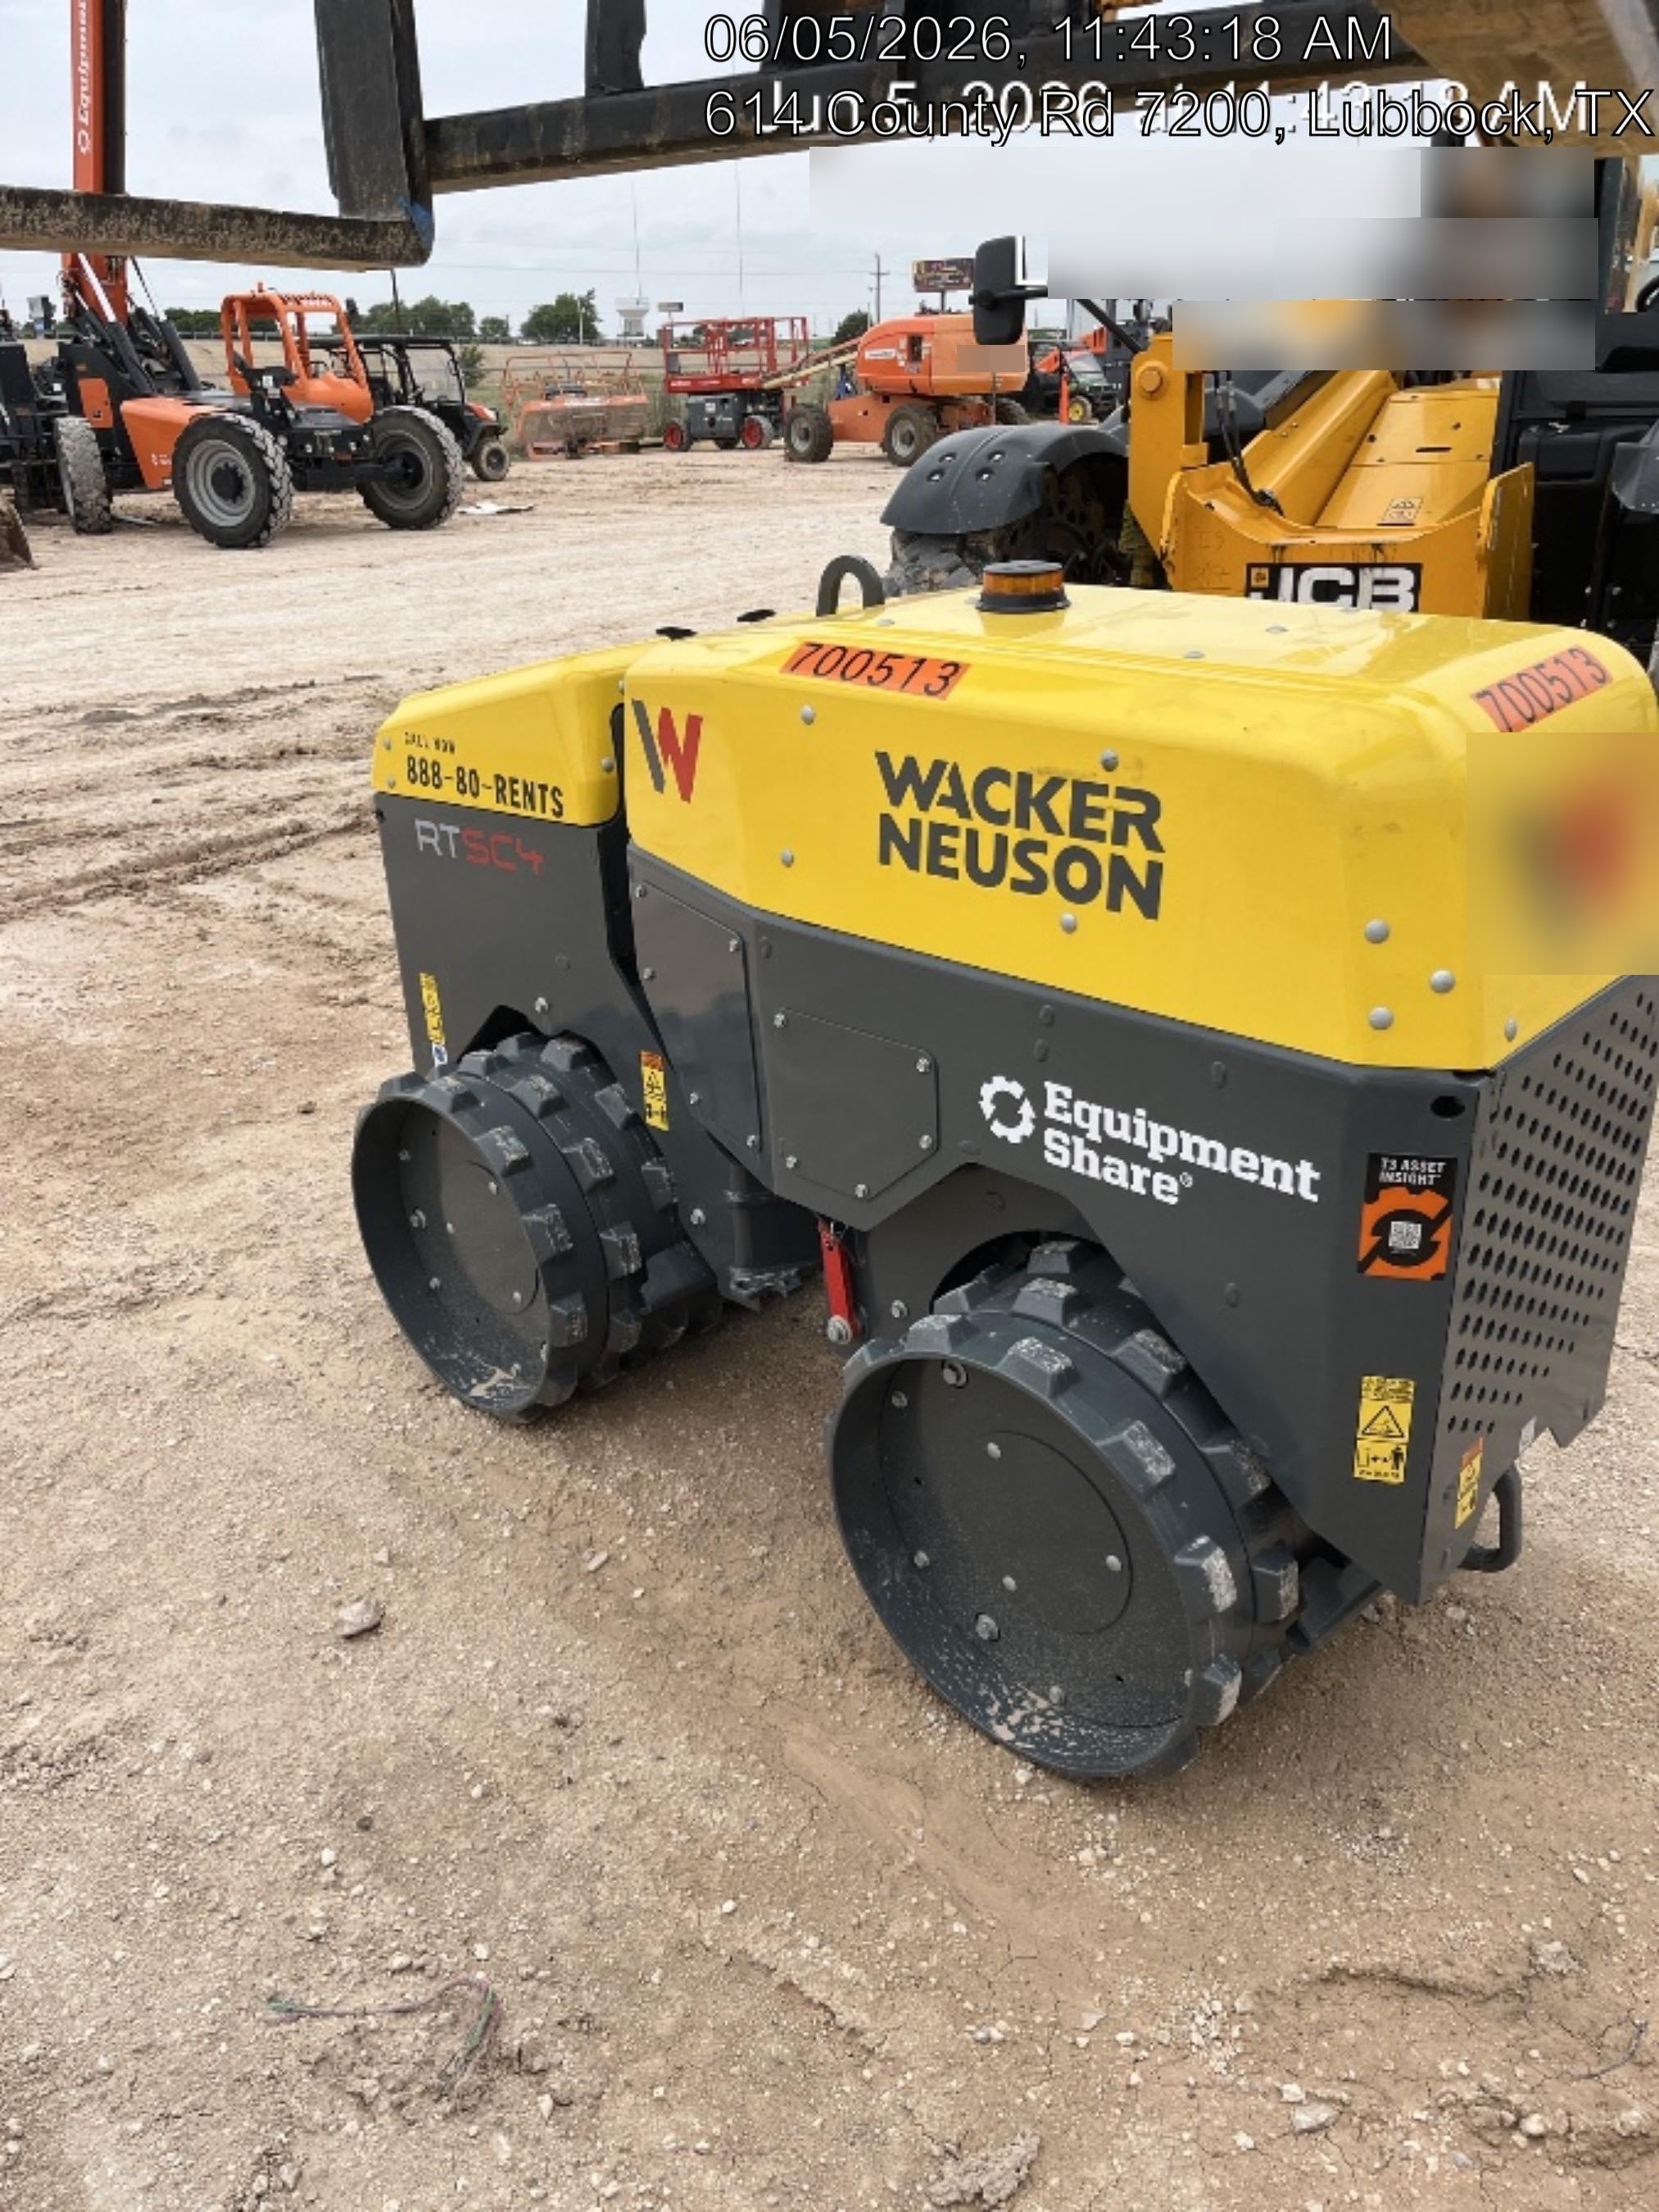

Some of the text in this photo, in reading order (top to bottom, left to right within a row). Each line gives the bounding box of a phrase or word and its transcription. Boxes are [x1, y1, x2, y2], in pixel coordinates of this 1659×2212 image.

[1249, 567, 1416, 612] JCB
[791, 641, 960, 696] 700513
[1475, 647, 1607, 732] 700513
[406, 755, 564, 818] 888-80-RENTS
[874, 750, 1165, 853] WACKER
[415, 819, 544, 877] RTSC4
[878, 813, 1163, 921] NEUSON
[1043, 1080, 1321, 1203] Equipment
[1400, 1158, 1447, 1173] ASSET
